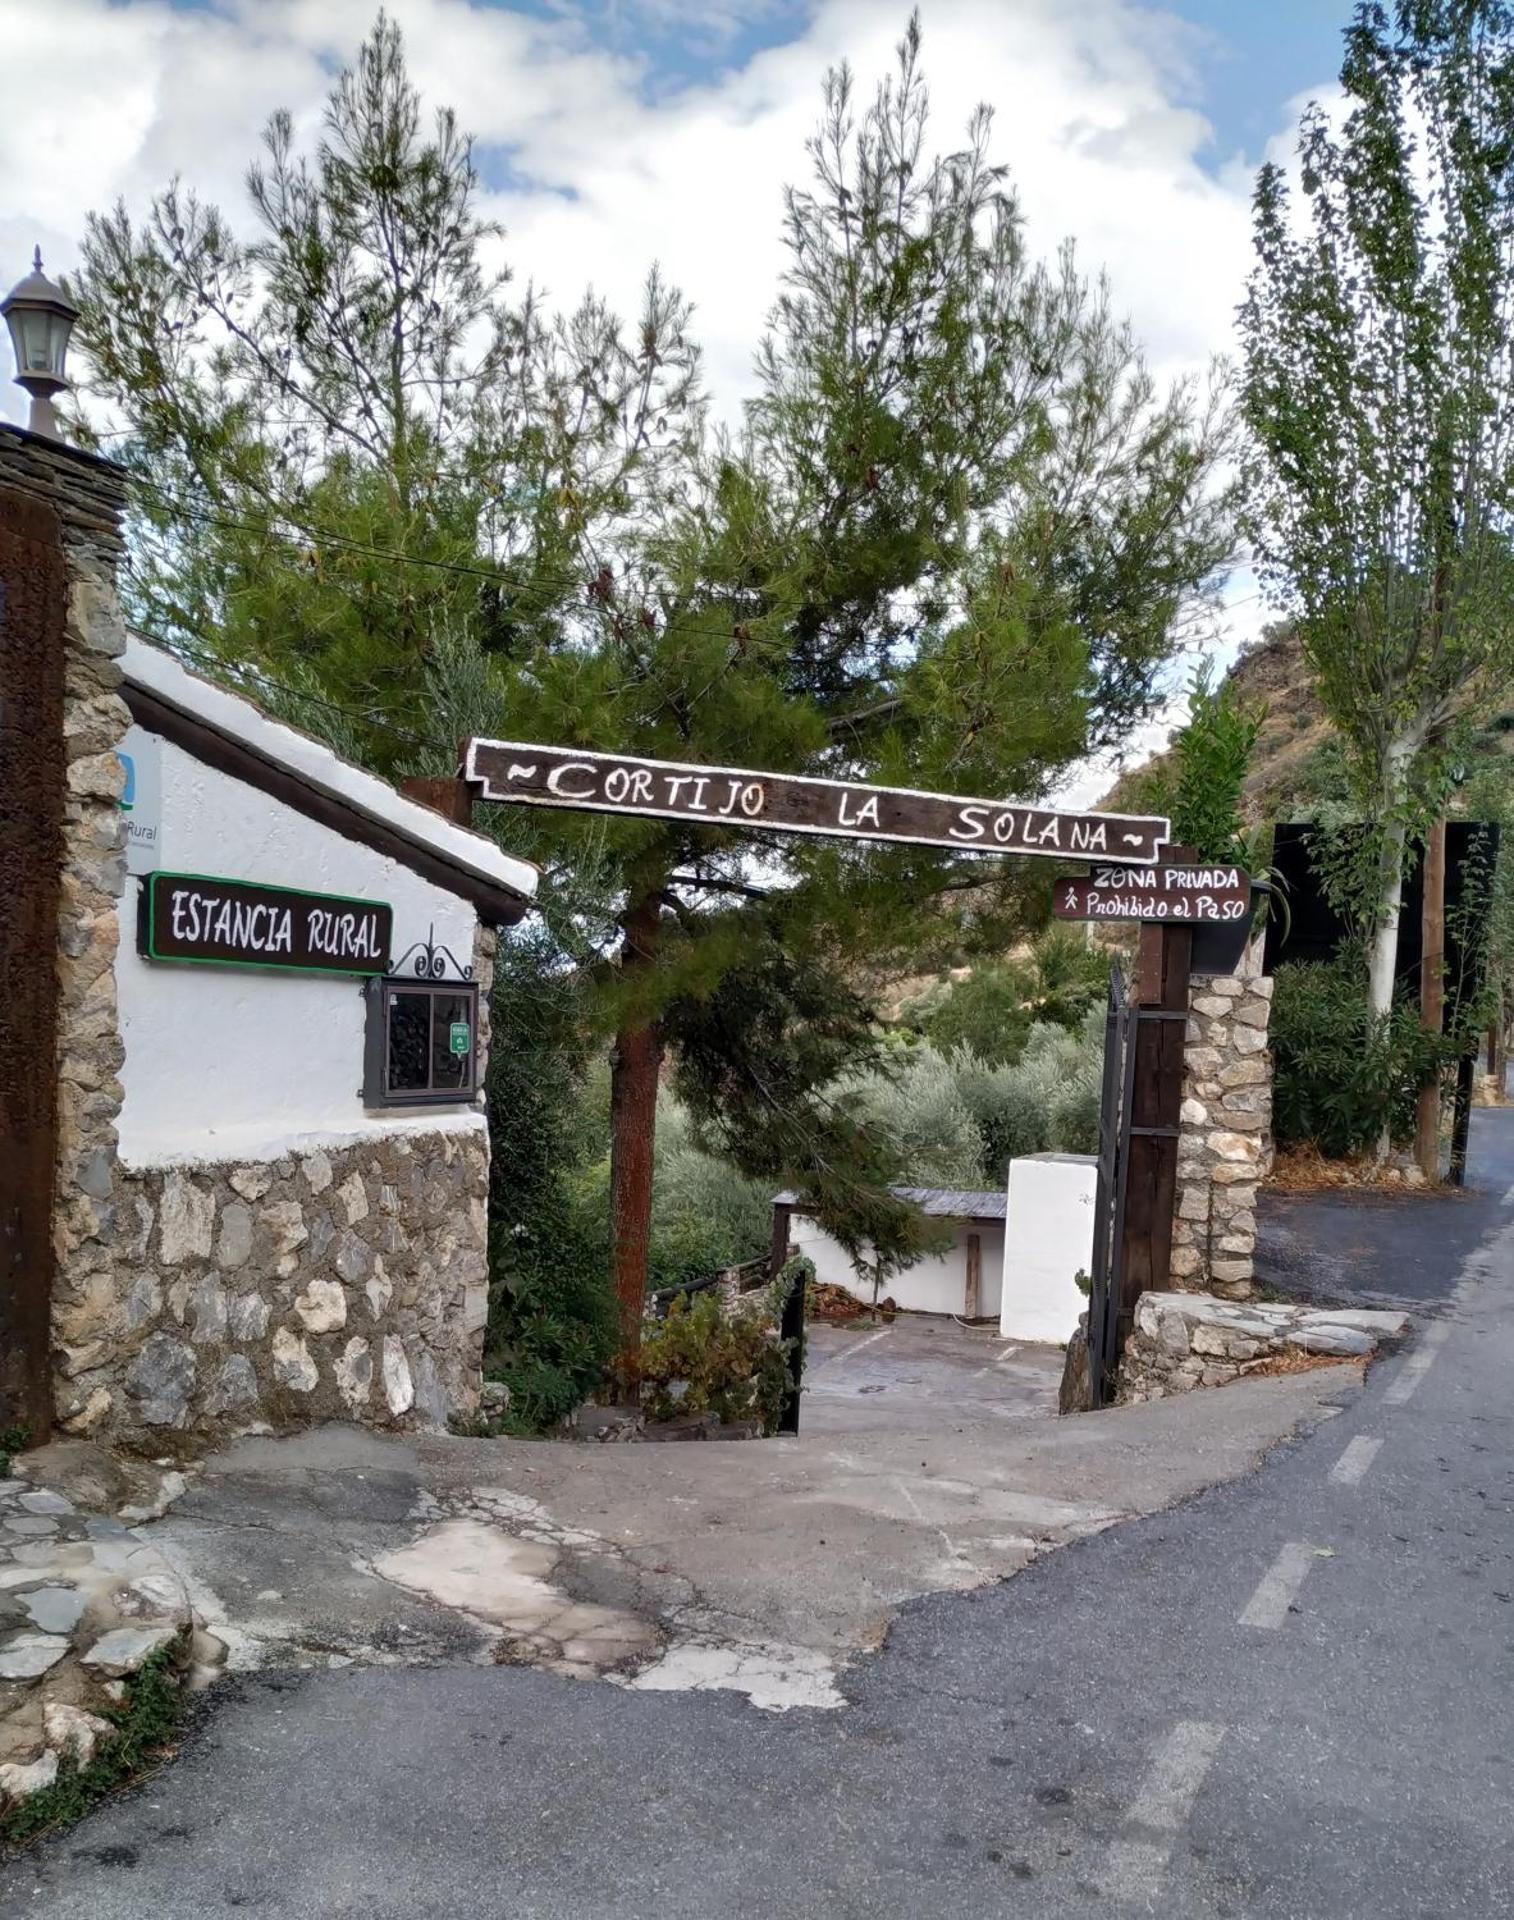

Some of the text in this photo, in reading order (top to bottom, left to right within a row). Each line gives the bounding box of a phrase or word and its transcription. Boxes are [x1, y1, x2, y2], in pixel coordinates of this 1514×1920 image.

[547, 763, 1108, 851] CORTIJO LA SOLANA
[127, 820, 157, 840] Rural
[1094, 867, 1157, 889] ZONA
[1086, 892, 1168, 918] Prohibido
[1173, 897, 1192, 918] el
[171, 890, 382, 958] ESTANCIA RURAL
